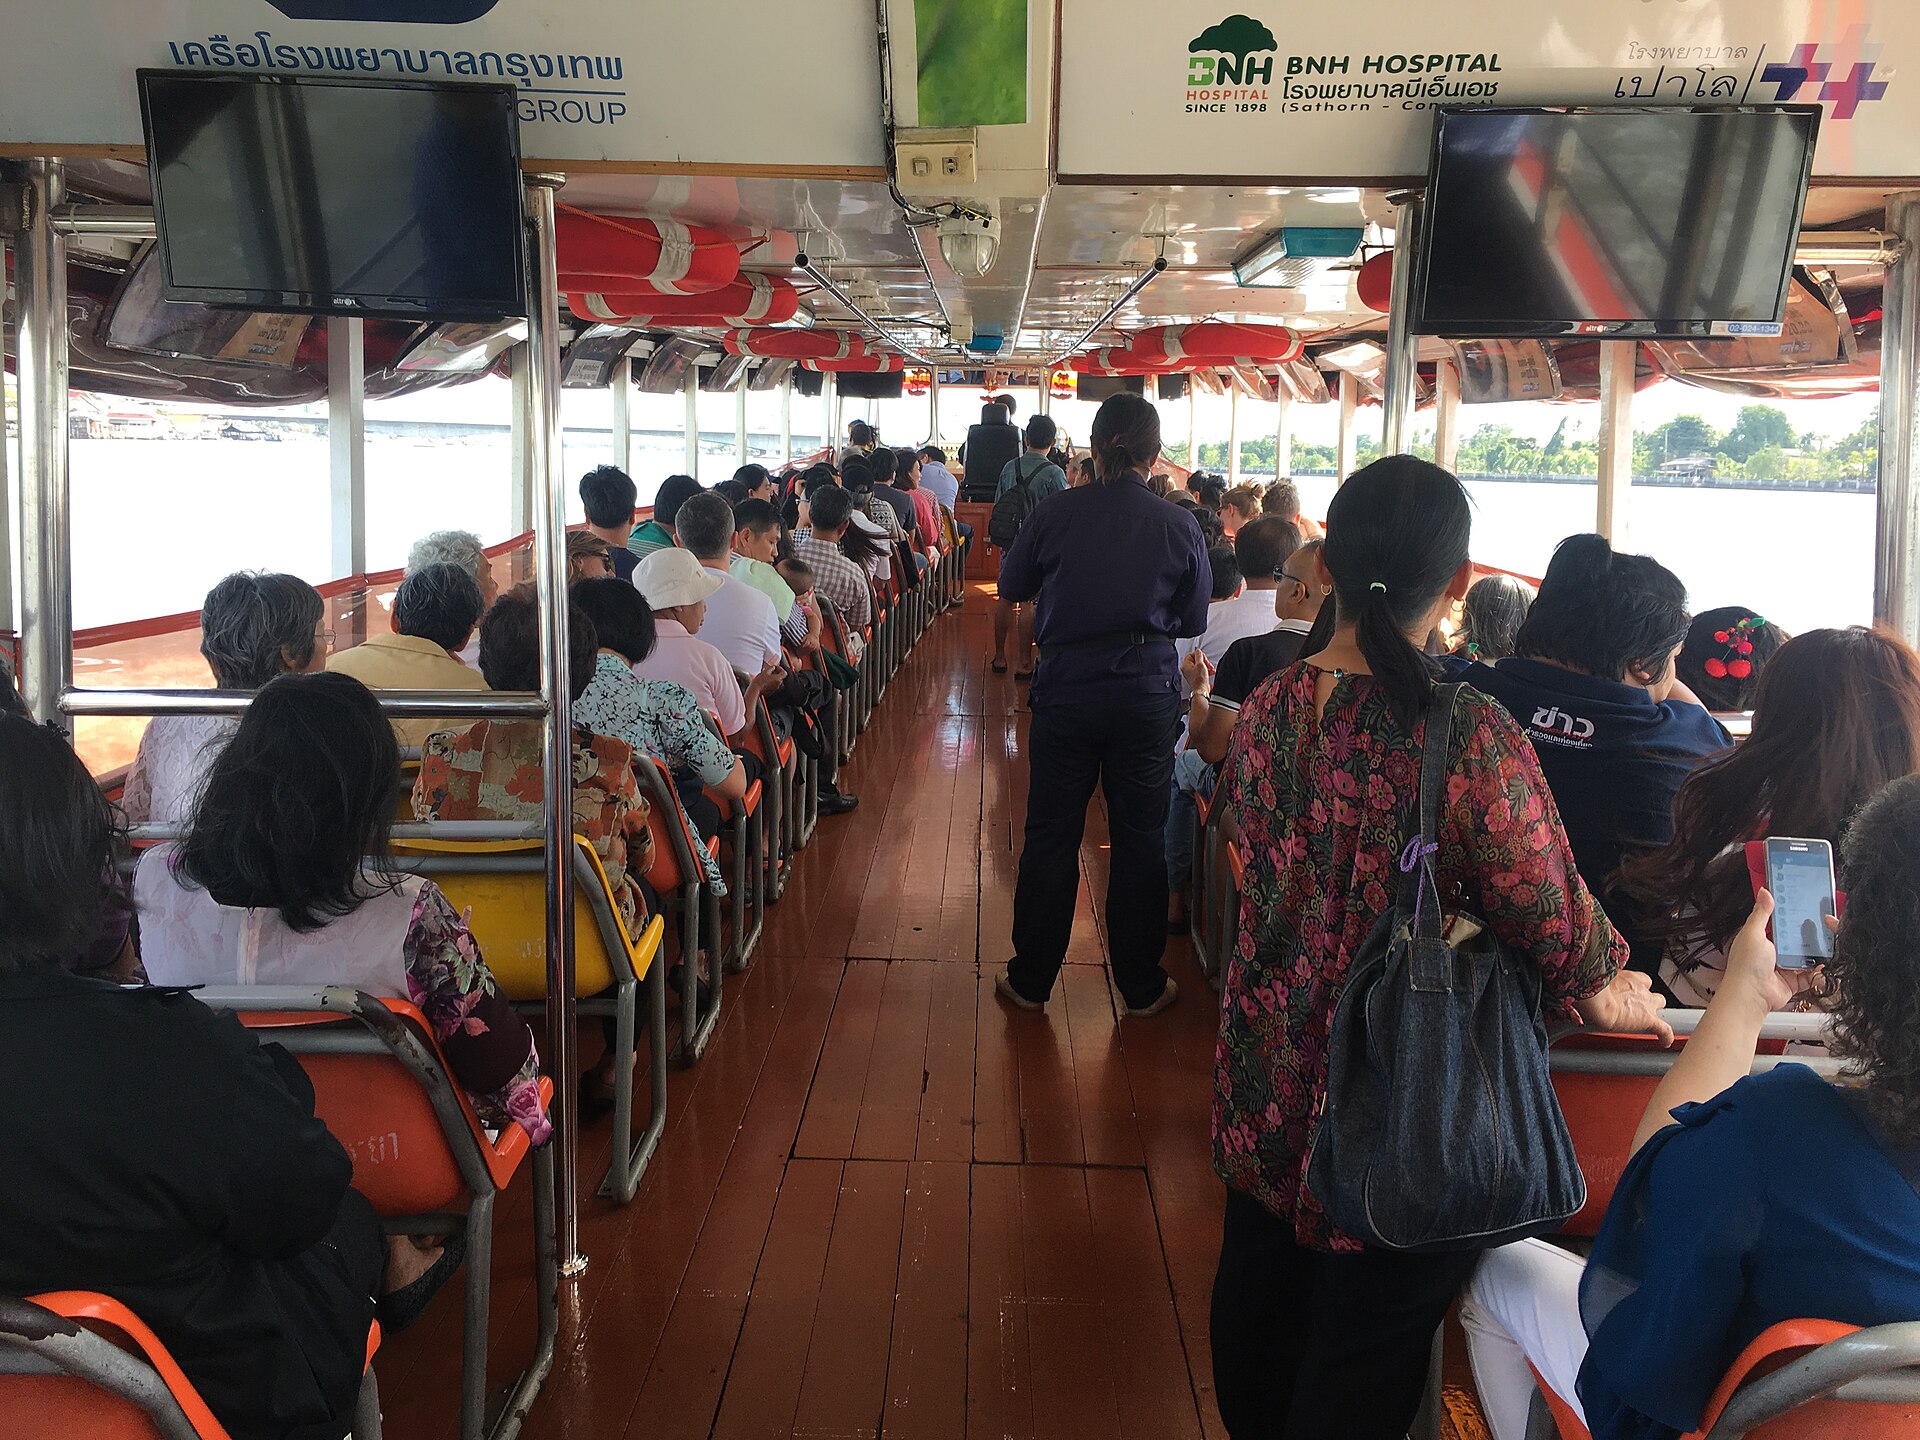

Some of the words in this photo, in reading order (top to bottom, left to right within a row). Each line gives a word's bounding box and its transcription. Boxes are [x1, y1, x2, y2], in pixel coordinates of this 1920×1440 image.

[168, 32, 623, 87] เครือโรงพยาบาลกรุงเทพ
[1628, 41, 1748, 60] โรงพยาบาล
[1187, 55, 1274, 86] BNH
[1286, 55, 1350, 75] BNH
[1362, 53, 1502, 74] HOSPITAL
[1283, 75, 1499, 99] โรงพยาบาลบีเอ็นเอช
[1614, 63, 1738, 98] เปาโล
[1186, 89, 1269, 101] HOSPITAL
[516, 98, 627, 125] GROUP
[1185, 103, 1227, 113] SINCE
[1235, 103, 1268, 113] 1898
[1281, 102, 1370, 113] (Sathorn
[1728, 322, 1780, 333] 02-024-1344
[1531, 706, 1595, 738] ข่าว
